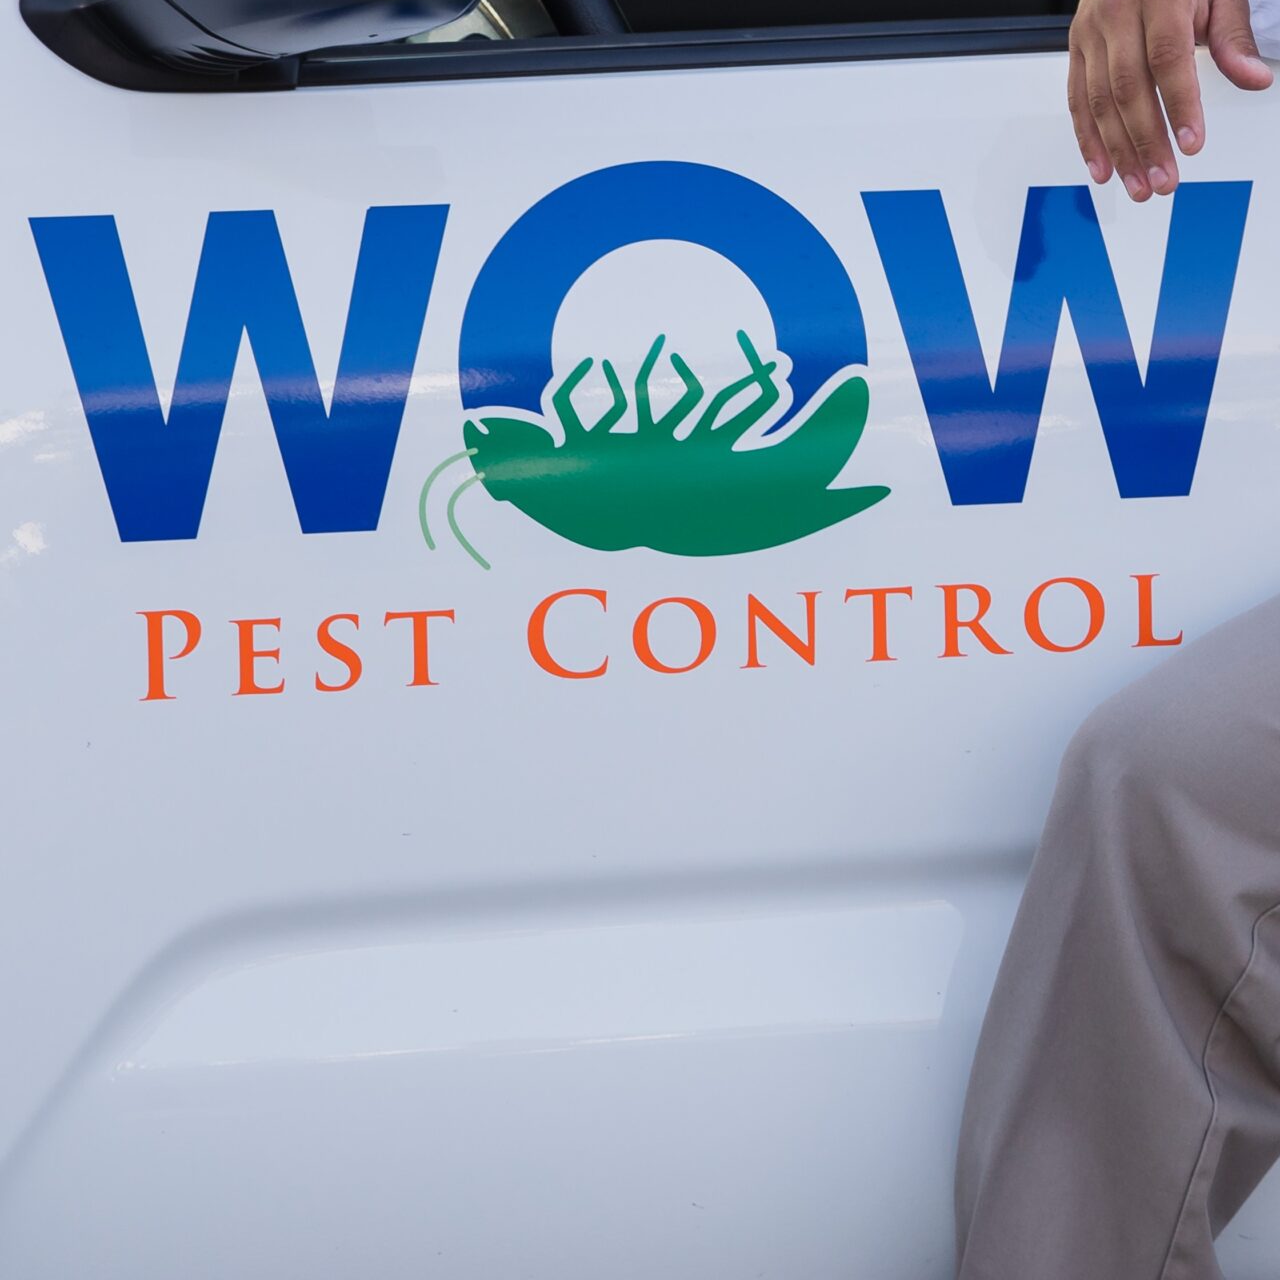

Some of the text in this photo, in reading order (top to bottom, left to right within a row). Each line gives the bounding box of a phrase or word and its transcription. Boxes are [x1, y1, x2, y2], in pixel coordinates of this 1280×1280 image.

[28, 160, 1254, 546] WOW
[136, 573, 1185, 702] PEST CONTROL
